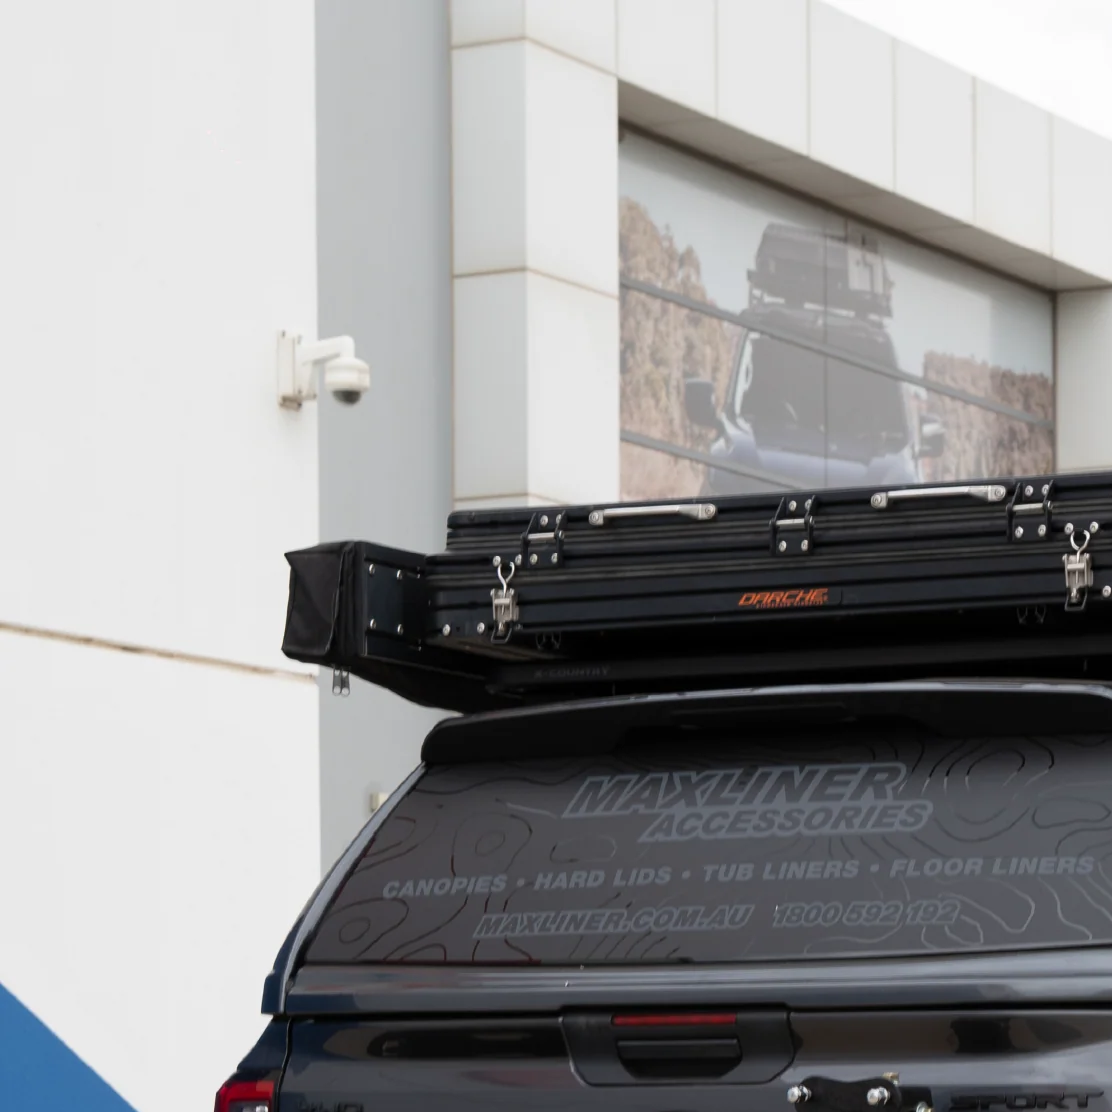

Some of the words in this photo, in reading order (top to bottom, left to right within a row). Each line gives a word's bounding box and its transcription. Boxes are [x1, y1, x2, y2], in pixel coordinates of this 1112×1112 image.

[738, 588, 829, 606] DARCHE
[562, 762, 907, 819] MAXLINER
[637, 800, 934, 843] ACCESSORIES
[382, 874, 508, 900] CANOPIES
[533, 868, 605, 891] HARD
[612, 866, 672, 888] LIDS
[703, 862, 754, 883] TUB
[762, 859, 860, 881] LINERS
[889, 856, 983, 878] FLOOR
[991, 855, 1095, 876] LINERS
[473, 902, 755, 940] MAXLINER.COM.AU
[773, 901, 843, 928] 1800
[842, 900, 903, 927] 592
[904, 898, 962, 926] 192
[949, 1090, 1105, 1112] SPORT
